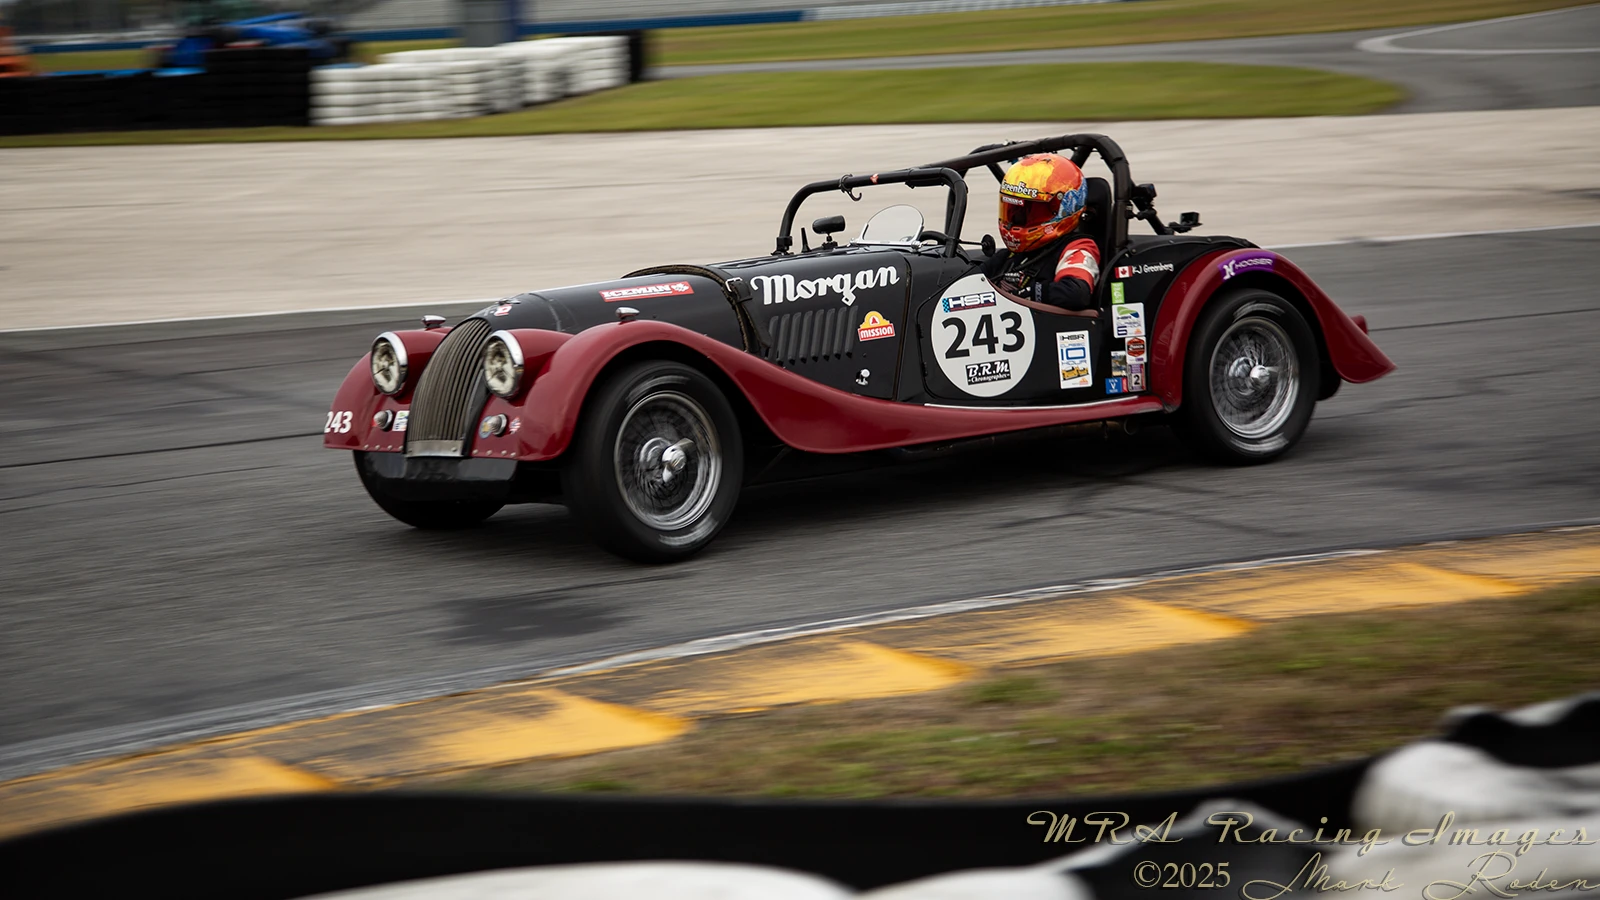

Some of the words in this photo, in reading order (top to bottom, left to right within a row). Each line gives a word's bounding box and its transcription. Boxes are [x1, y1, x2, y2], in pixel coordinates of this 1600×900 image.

[1235, 258, 1273, 269] HOOSIER
[602, 284, 673, 298] ICEMAN
[750, 266, 900, 306] Morgan
[949, 292, 995, 308] HSR
[942, 311, 1025, 359] 243
[1133, 374, 1140, 385] 2
[324, 410, 353, 433] 243
